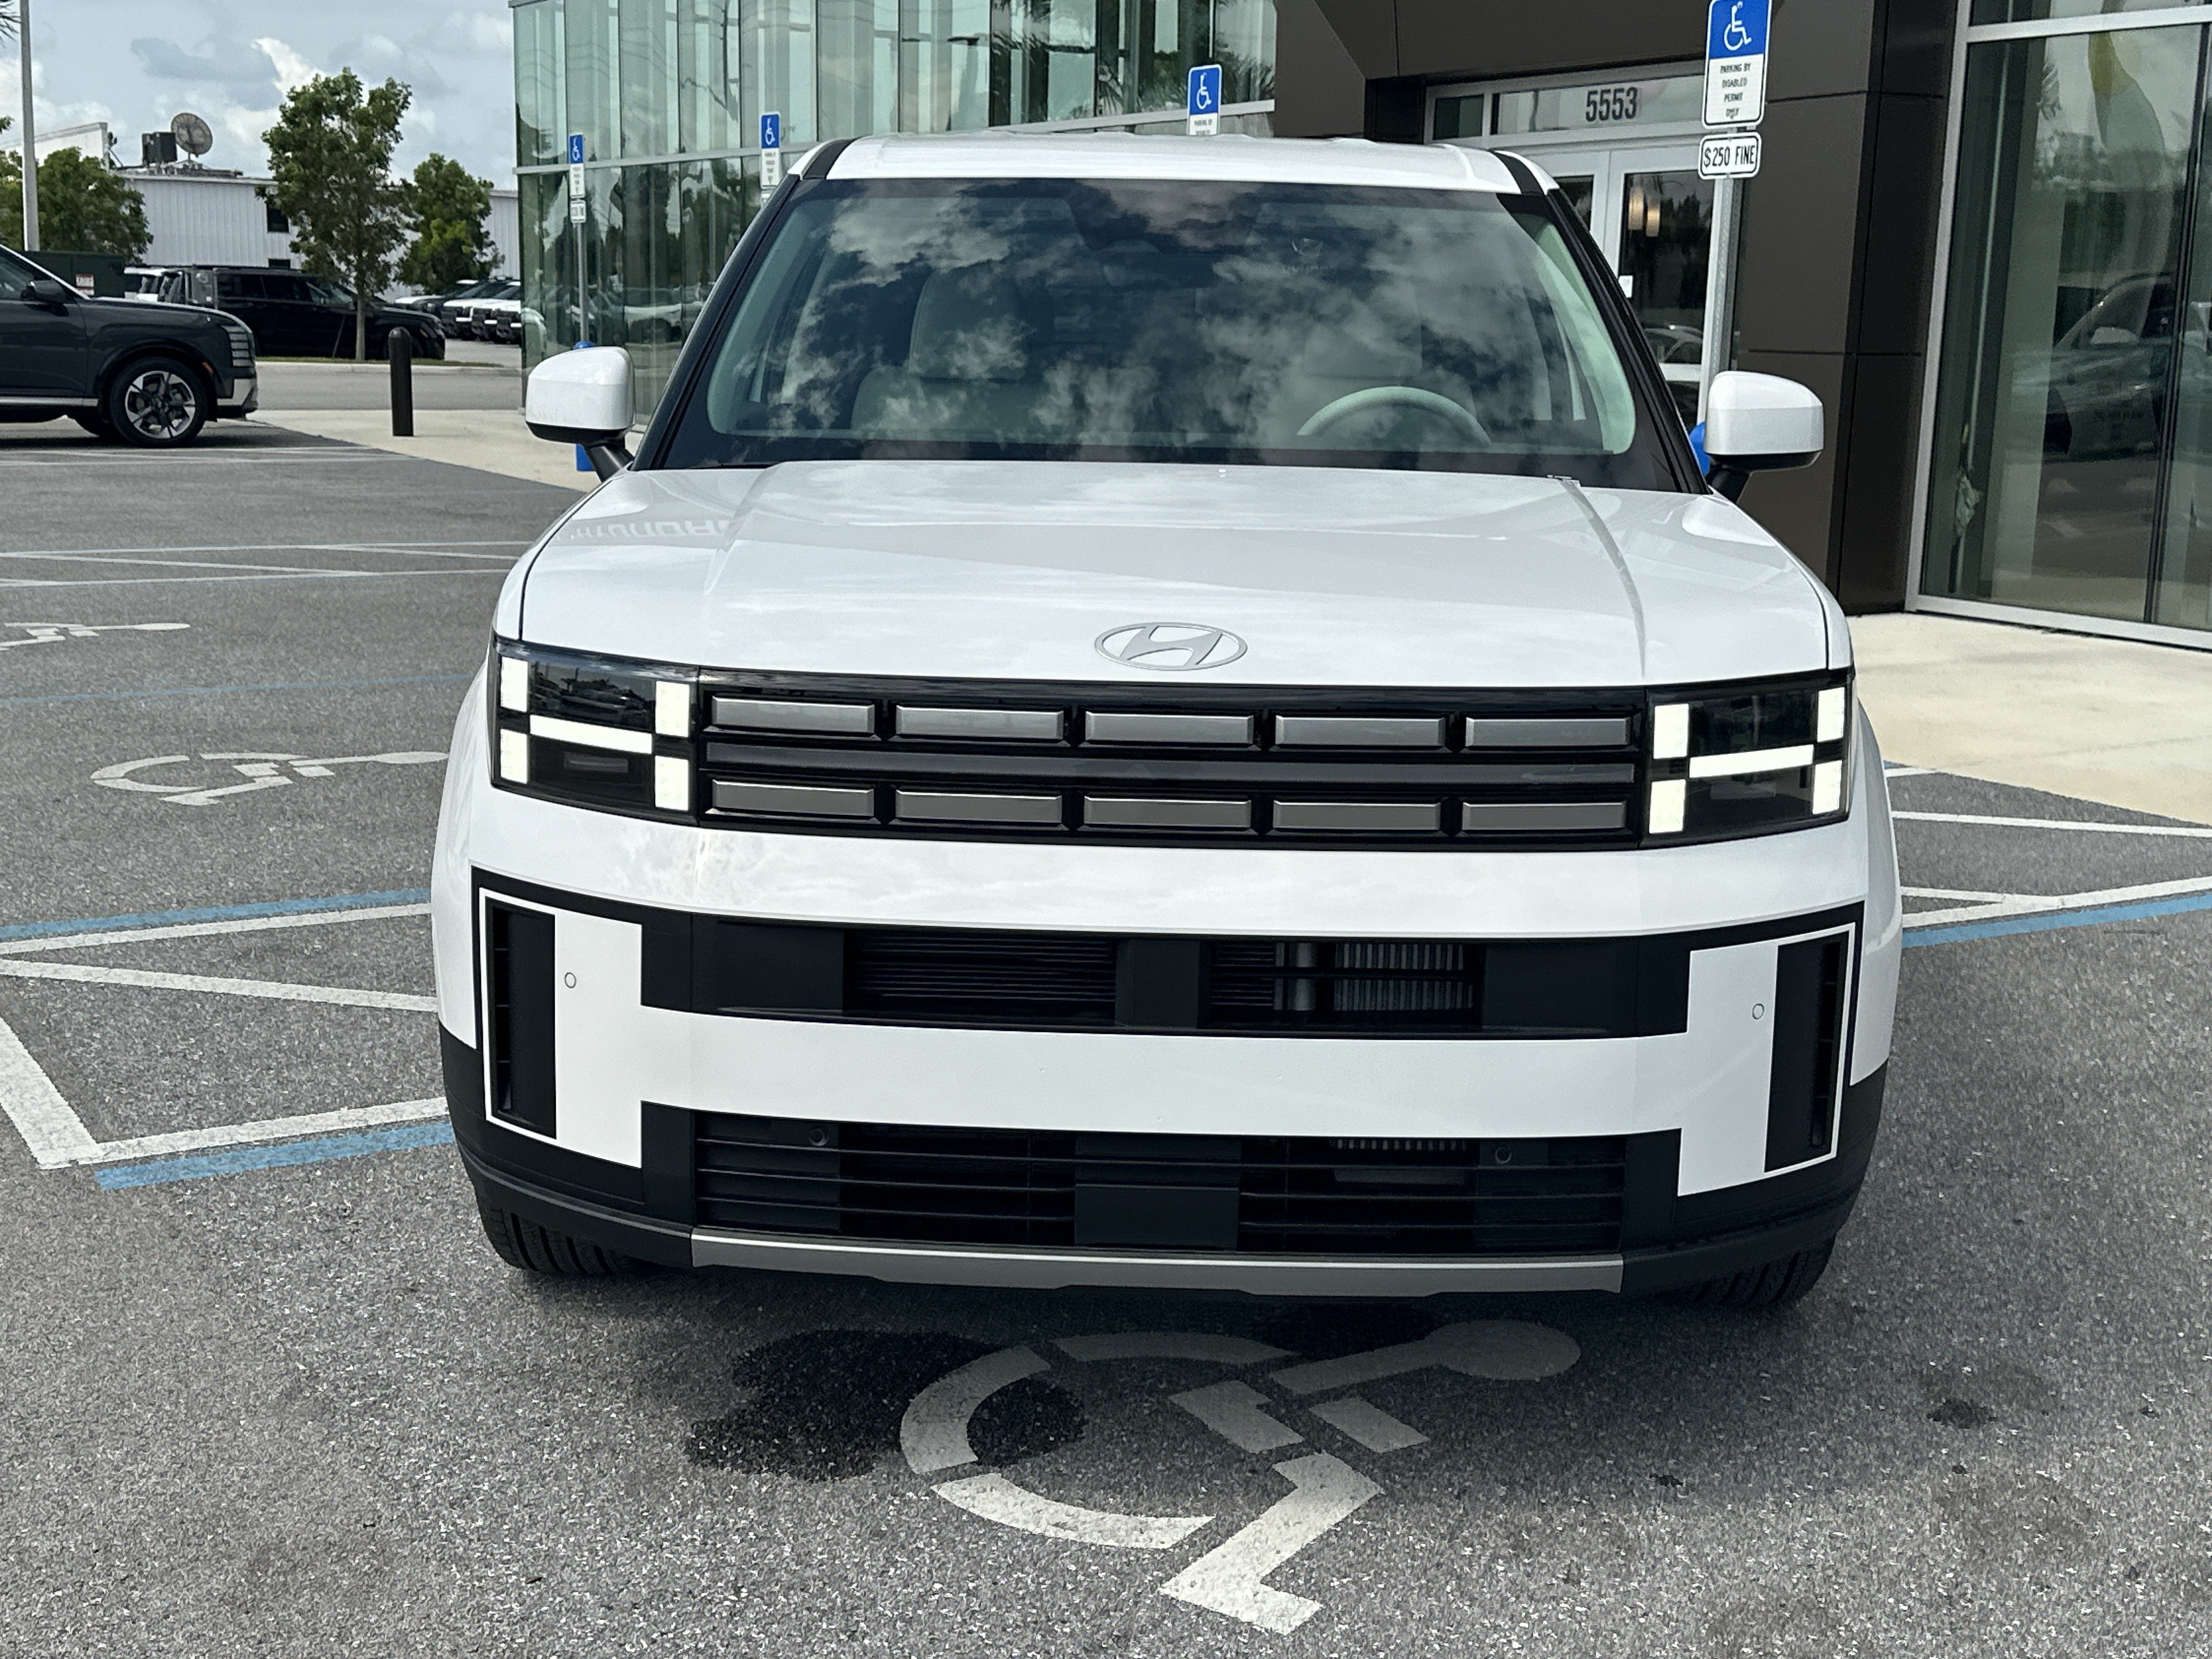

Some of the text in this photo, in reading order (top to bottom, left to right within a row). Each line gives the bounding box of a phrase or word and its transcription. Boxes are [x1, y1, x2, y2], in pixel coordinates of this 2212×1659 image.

[1743, 63, 1752, 72] BY
[1585, 87, 1638, 122] 5553
[1703, 145, 1756, 169] $250 FINE
